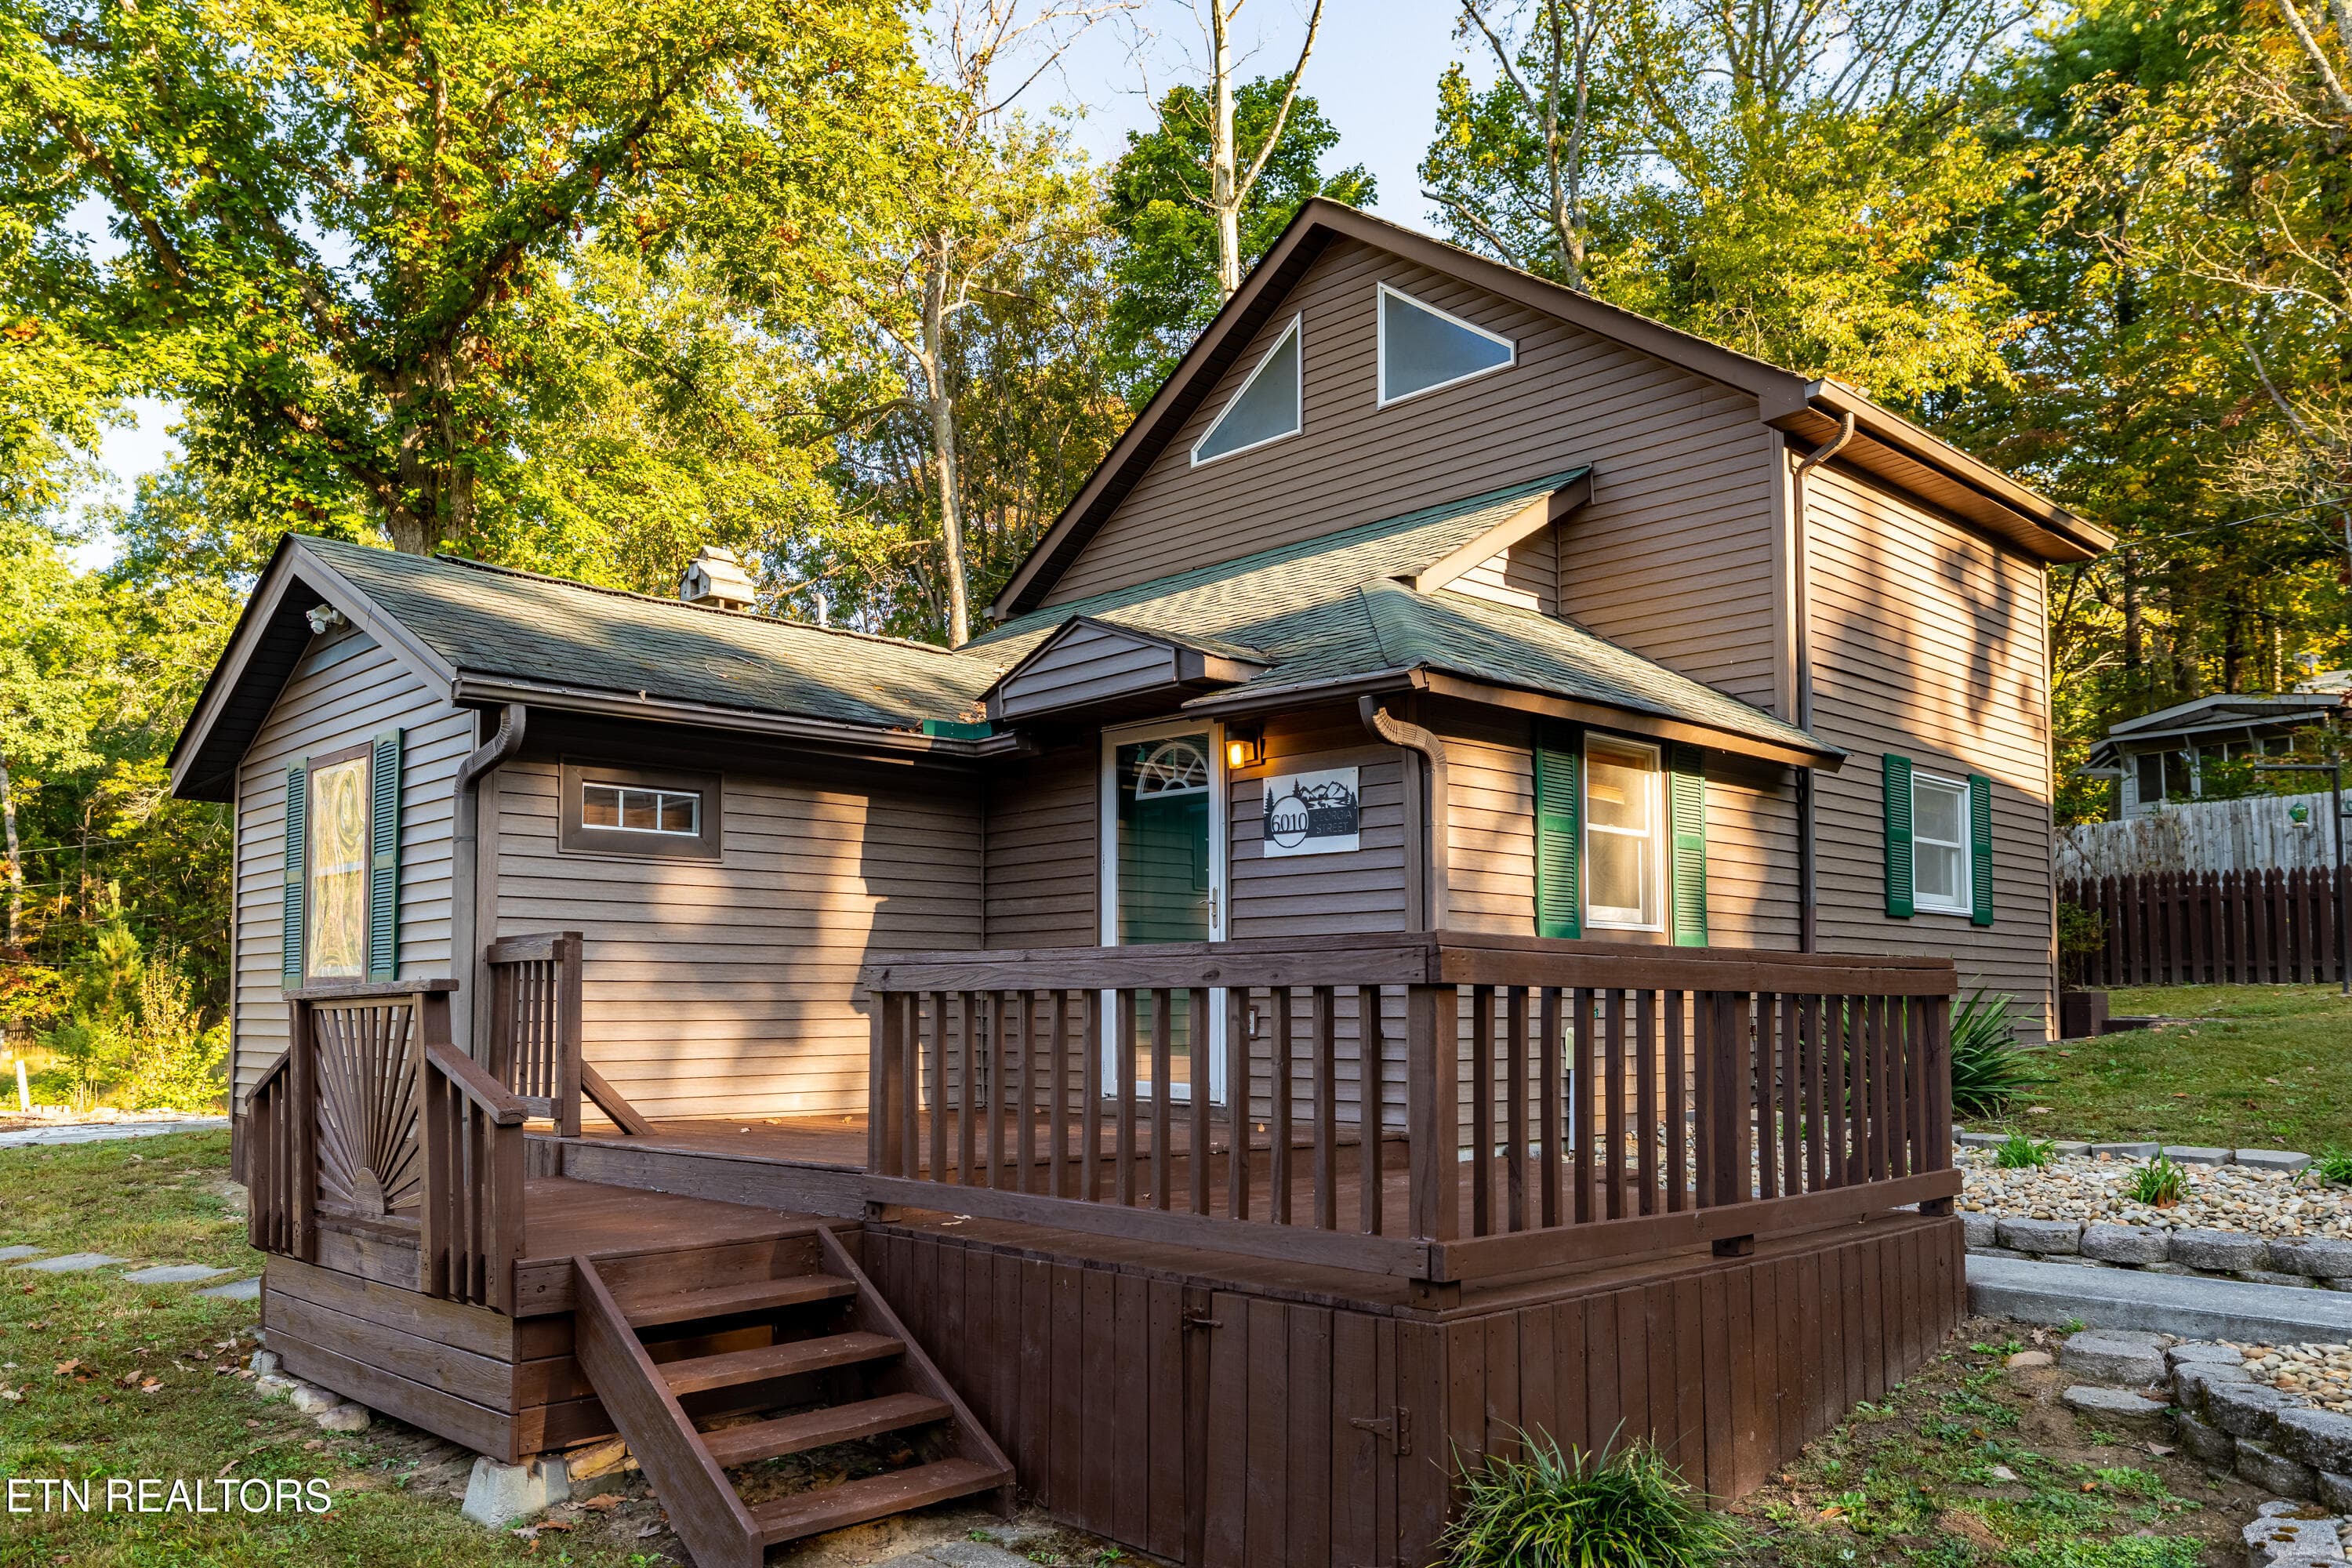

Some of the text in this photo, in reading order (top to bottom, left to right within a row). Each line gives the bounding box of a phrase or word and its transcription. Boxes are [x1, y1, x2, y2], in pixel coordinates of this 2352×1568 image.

[1272, 812, 1308, 832] 6010
[1312, 810, 1352, 822] GEORGIA
[1316, 822, 1348, 833] STREET
